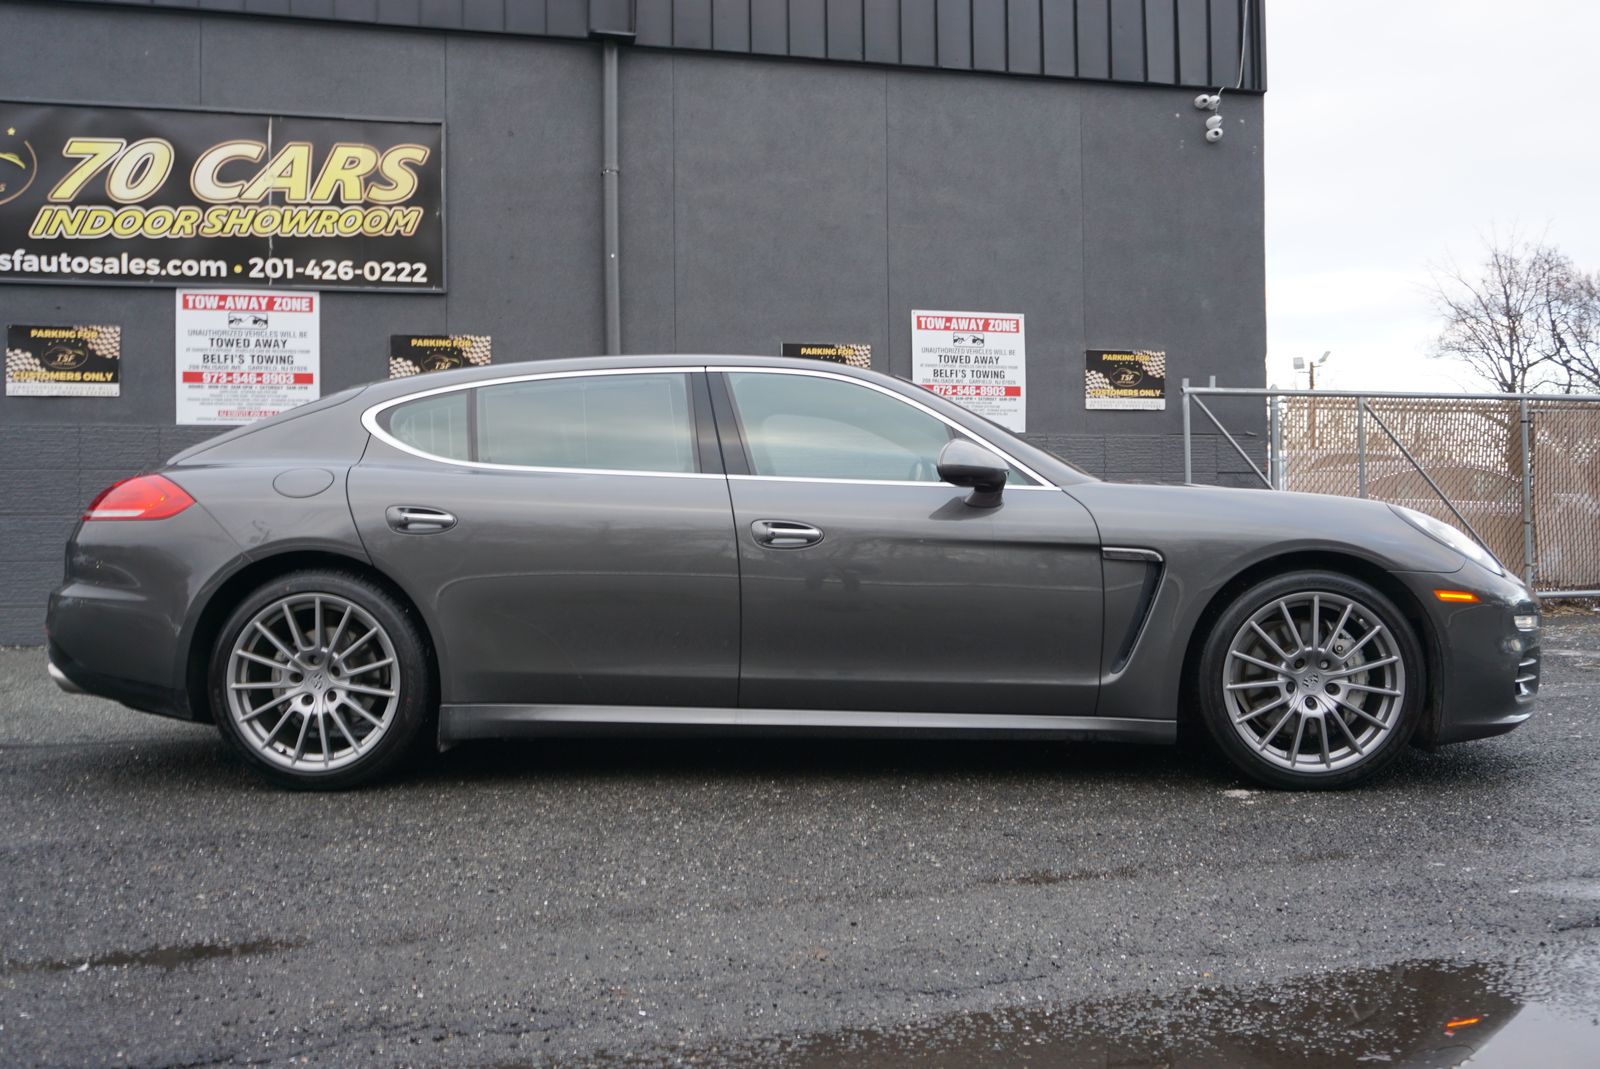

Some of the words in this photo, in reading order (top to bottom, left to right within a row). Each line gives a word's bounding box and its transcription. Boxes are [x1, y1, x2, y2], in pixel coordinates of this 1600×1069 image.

[48, 137, 175, 203] 70
[190, 139, 430, 204] CARS
[29, 205, 199, 239] INDOOR
[199, 206, 423, 238] SHOWROOM
[248, 257, 428, 283] 201-426-0222
[186, 295, 270, 311] TOW-AWAY
[273, 297, 310, 312] ZONE
[919, 317, 985, 331] TOW-AWAY
[988, 318, 1018, 331] ZONE
[30, 329, 77, 339] PARKING
[77, 329, 98, 340] FOR
[187, 329, 243, 337] UNAUTHORIZED
[244, 330, 278, 338] VEHICLES
[208, 337, 251, 348] TOWED
[254, 338, 288, 349] AWAY
[411, 338, 452, 347] PARKING
[453, 339, 472, 348] FOR
[801, 347, 836, 356] PARKING
[838, 348, 854, 356] FOR
[921, 347, 965, 355] UNAUTHORIZED
[966, 348, 992, 356] VEHICLES
[202, 354, 245, 365] BELFI'S
[250, 355, 294, 366] TOWING
[938, 354, 971, 364] TOWED
[974, 355, 1000, 365] AWAY
[13, 371, 81, 381] CUSTOMERS
[83, 372, 113, 382] ONLY
[933, 368, 967, 378] BELFI'S
[970, 369, 1005, 379] TOWING
[933, 385, 1006, 396] 973-546-8903
[1140, 389, 1160, 397] ONLY
